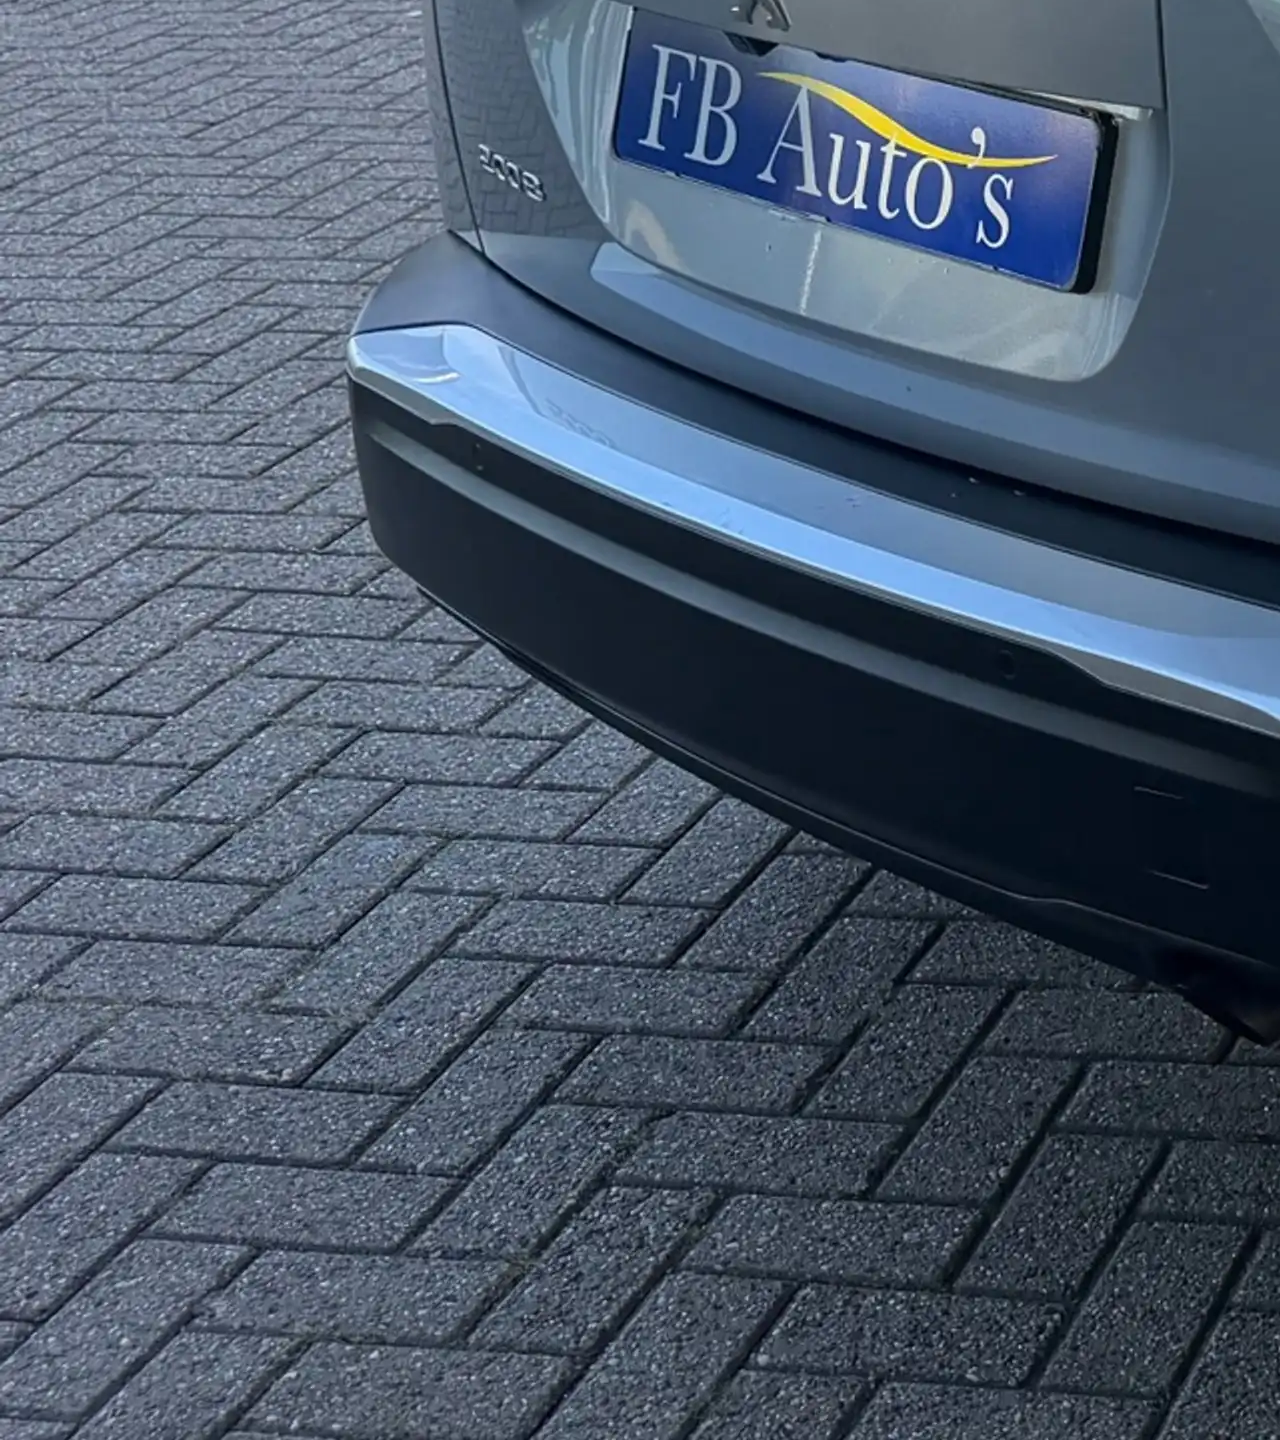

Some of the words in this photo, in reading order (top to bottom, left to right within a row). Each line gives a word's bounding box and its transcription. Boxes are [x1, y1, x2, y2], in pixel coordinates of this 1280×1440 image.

[478, 143, 544, 202] 2008
[637, 43, 743, 166] FB
[756, 85, 1013, 250] Auto's
